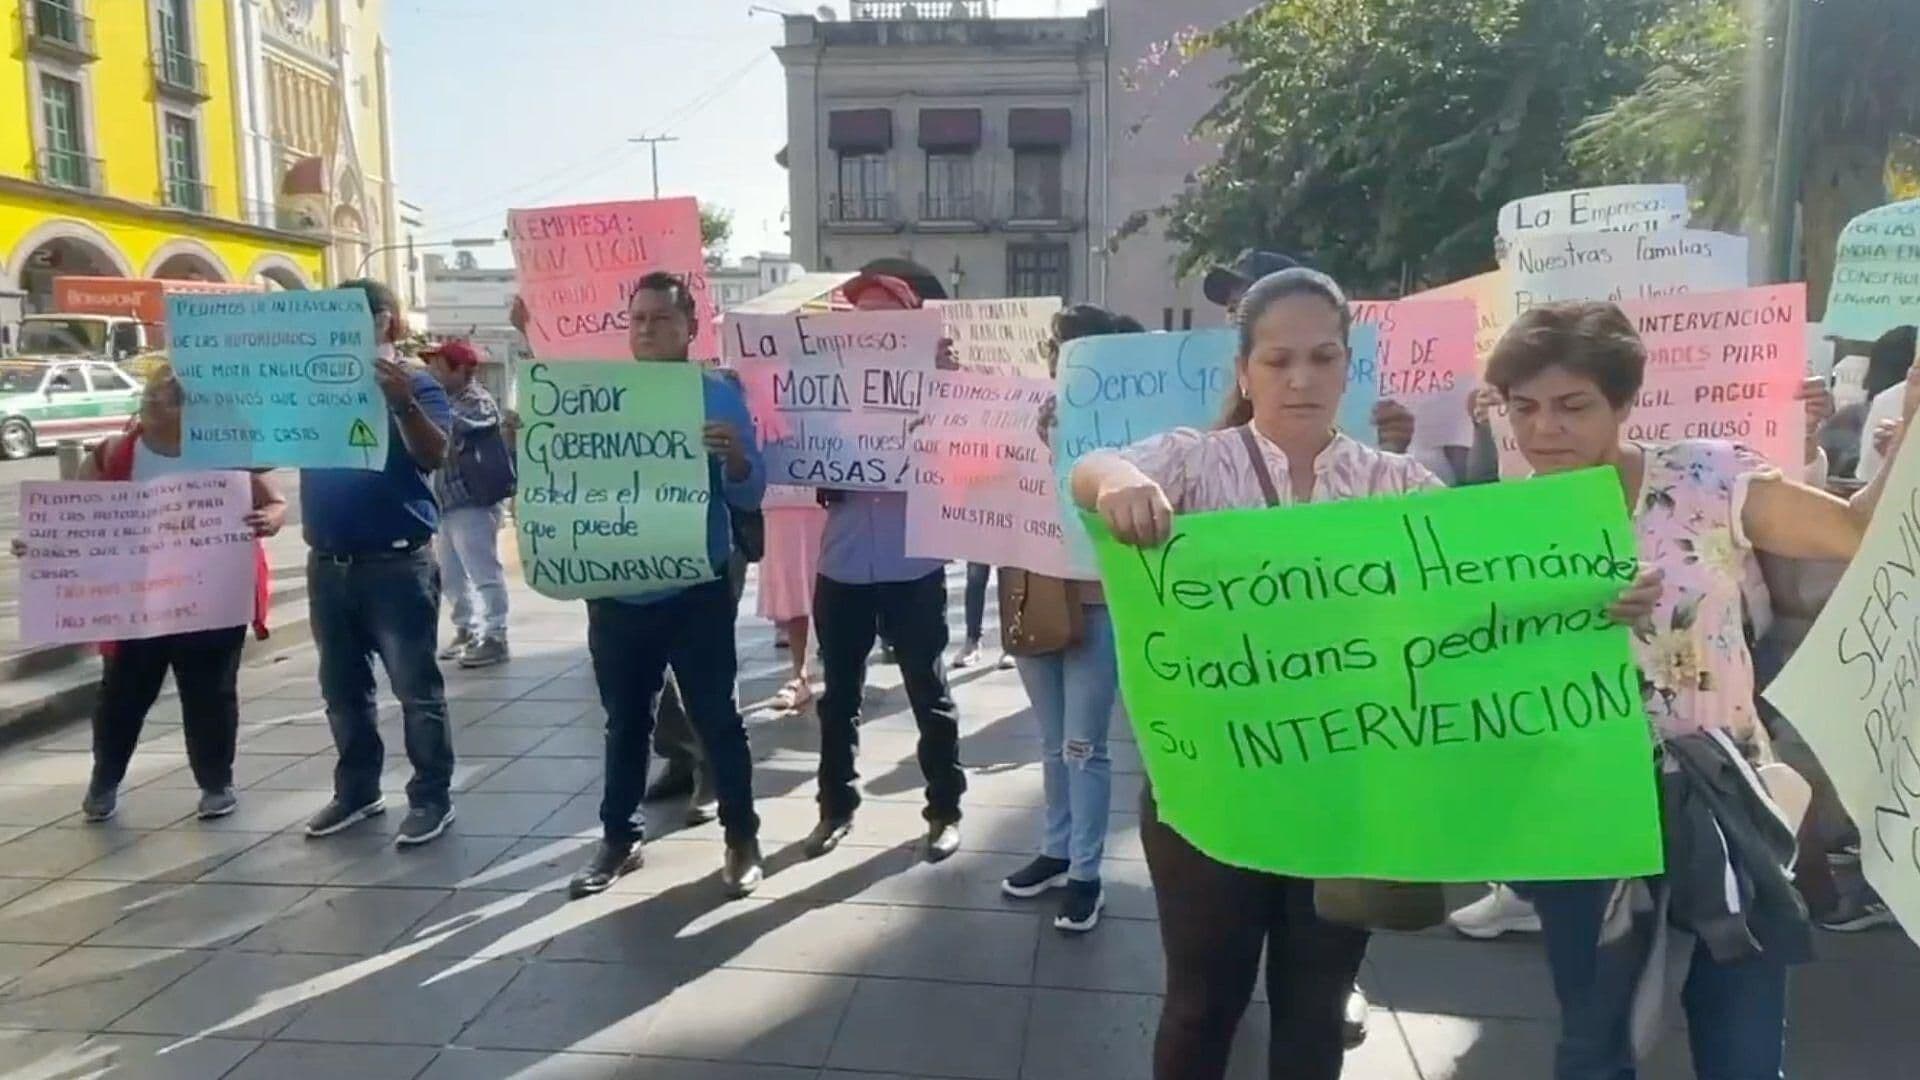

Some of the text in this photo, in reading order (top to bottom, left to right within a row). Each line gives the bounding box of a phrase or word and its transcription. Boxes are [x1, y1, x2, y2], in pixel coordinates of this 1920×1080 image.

[1516, 202, 1550, 229] La
[1519, 241, 1613, 274] Nuestras
[736, 322, 778, 359] La
[1411, 337, 1439, 365] DE
[1722, 342, 1778, 363] PARA
[530, 363, 627, 416] Señor
[773, 369, 924, 406] MOTA ENGI
[1380, 369, 1456, 398] ESTRAS
[1695, 382, 1770, 404] PAGUE
[1627, 422, 1671, 441] QUE
[1765, 421, 1779, 438] A
[524, 471, 577, 504] usted
[585, 486, 608, 504] es
[616, 470, 639, 504] el
[523, 506, 638, 554] que puede
[1135, 533, 1396, 611] Verónica
[1144, 602, 1616, 711] Giadians pedimos
[1228, 664, 1631, 769] INTERVENCION
